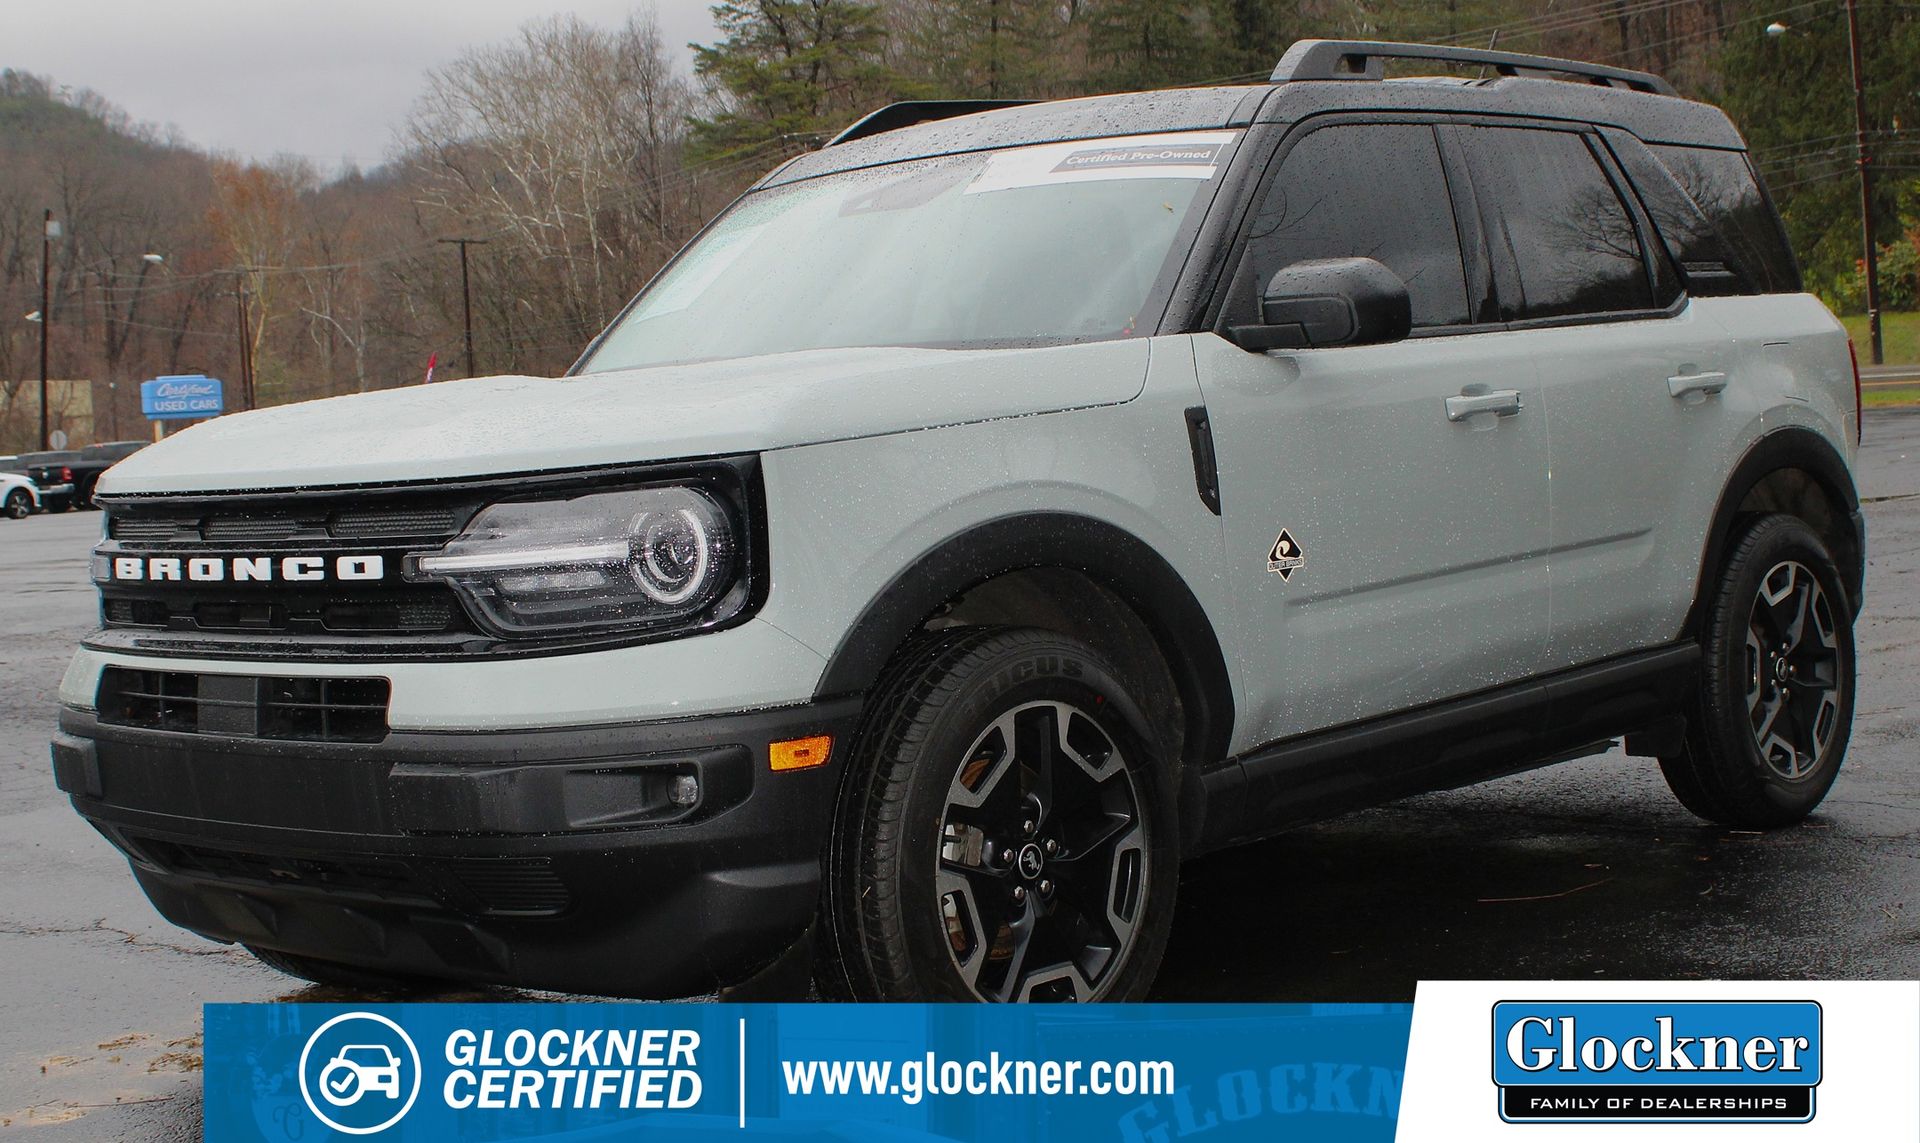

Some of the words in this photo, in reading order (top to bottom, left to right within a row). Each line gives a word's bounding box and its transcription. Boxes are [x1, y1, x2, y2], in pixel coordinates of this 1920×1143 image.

[1067, 152, 1127, 165] Certified
[1131, 150, 1211, 160] Pre-Owned
[154, 401, 187, 411] USED
[190, 400, 218, 410] CARS
[115, 556, 384, 581] BRONCO
